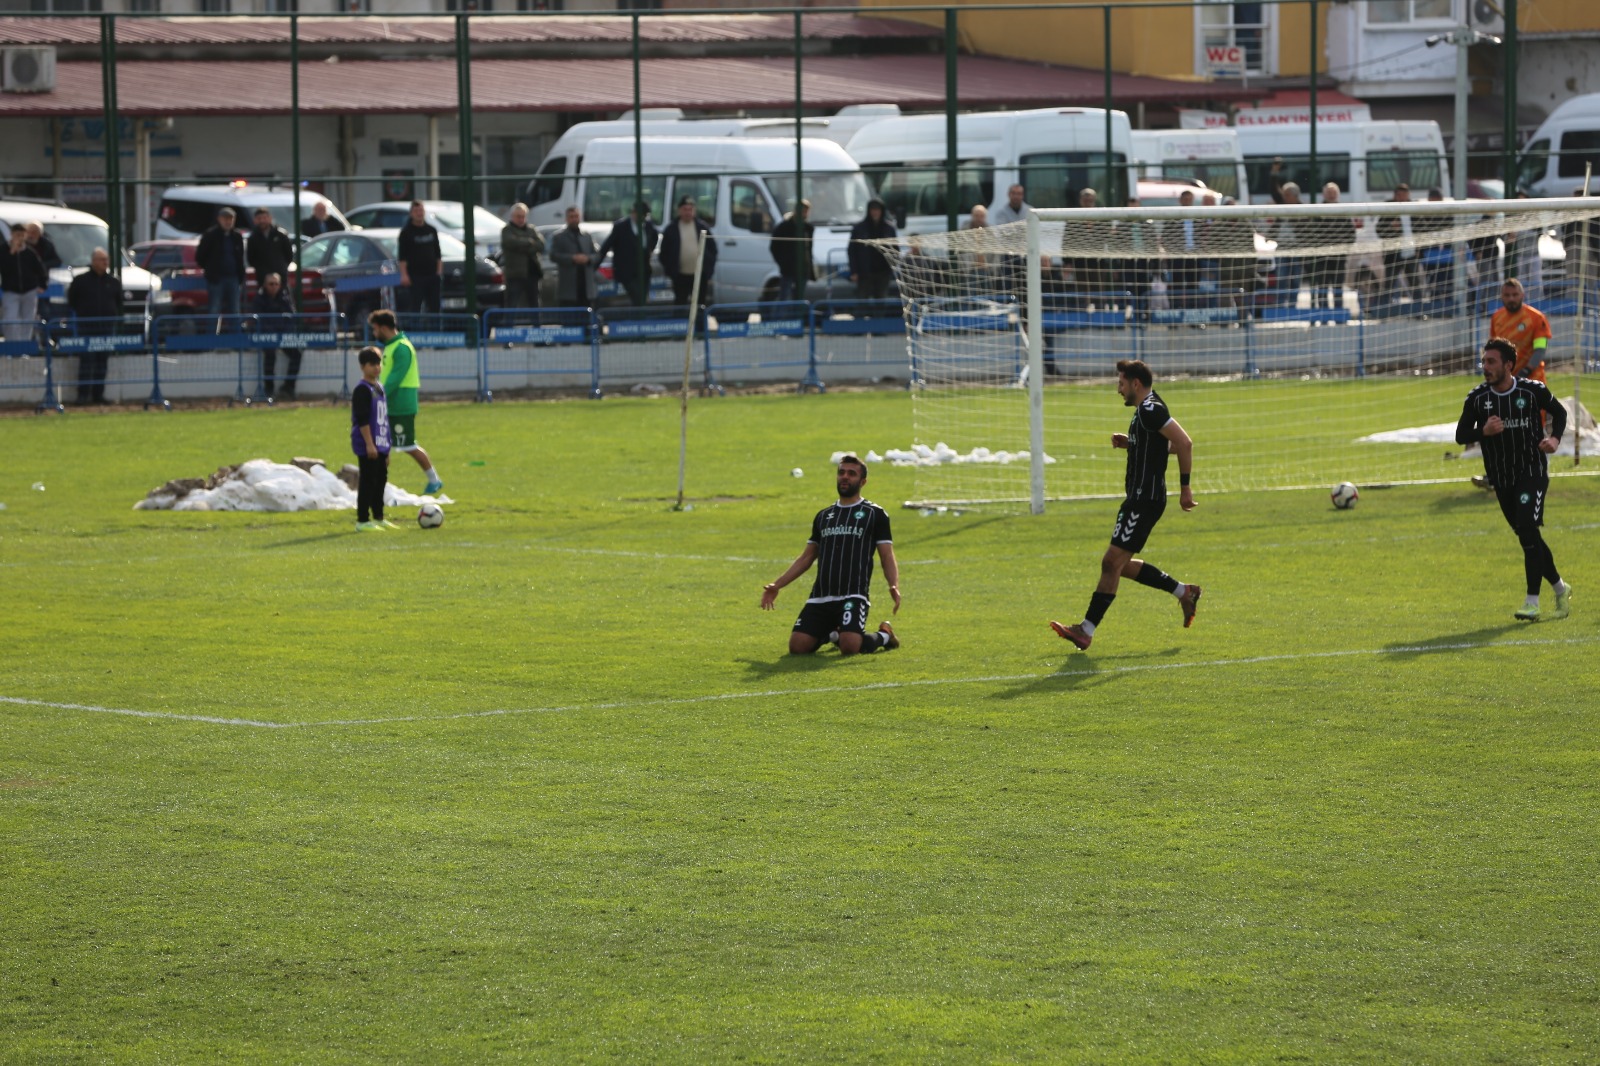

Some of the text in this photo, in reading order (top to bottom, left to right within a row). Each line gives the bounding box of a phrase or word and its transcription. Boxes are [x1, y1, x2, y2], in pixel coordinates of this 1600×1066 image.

[1206, 47, 1240, 62] WC
[1112, 523, 1122, 538] 8
[842, 610, 852, 625] 9
